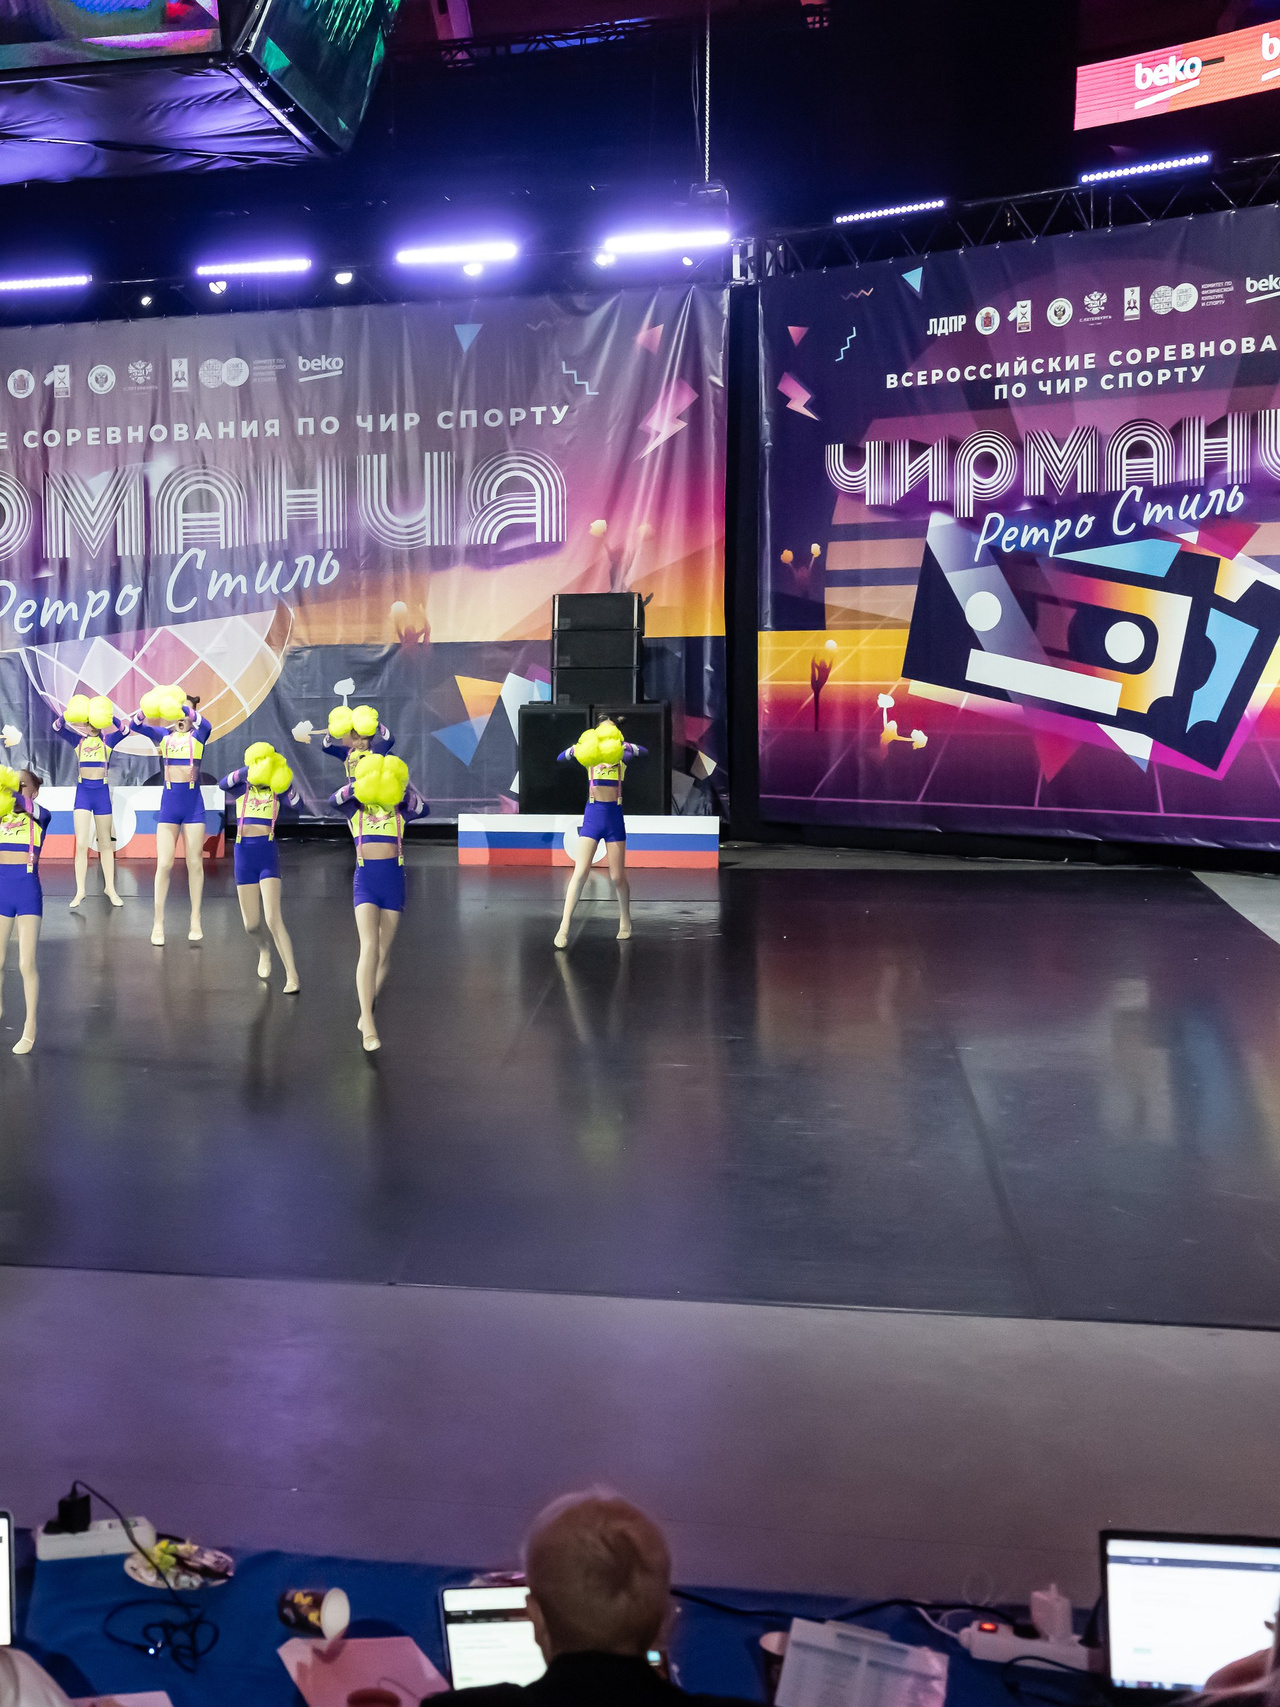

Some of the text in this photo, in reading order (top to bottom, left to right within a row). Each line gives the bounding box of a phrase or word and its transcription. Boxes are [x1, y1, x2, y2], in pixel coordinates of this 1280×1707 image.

[1134, 55, 1203, 91] beko
[1245, 274, 1280, 293] bek
[926, 315, 967, 337] ЛДПР
[298, 355, 344, 372] beko
[886, 352, 1097, 389] ВСЕРОССИЙСКИЕ
[994, 365, 1206, 400] ПО ЧИР СПОРТУ
[23, 419, 280, 449] СОРЕВНОВАНИЯ
[298, 416, 340, 436] ПО
[356, 411, 420, 432] ЧИР
[438, 404, 569, 428] СПОРТУ
[974, 485, 1244, 562] Ретро Стиль
[166, 547, 340, 613] Стиль
